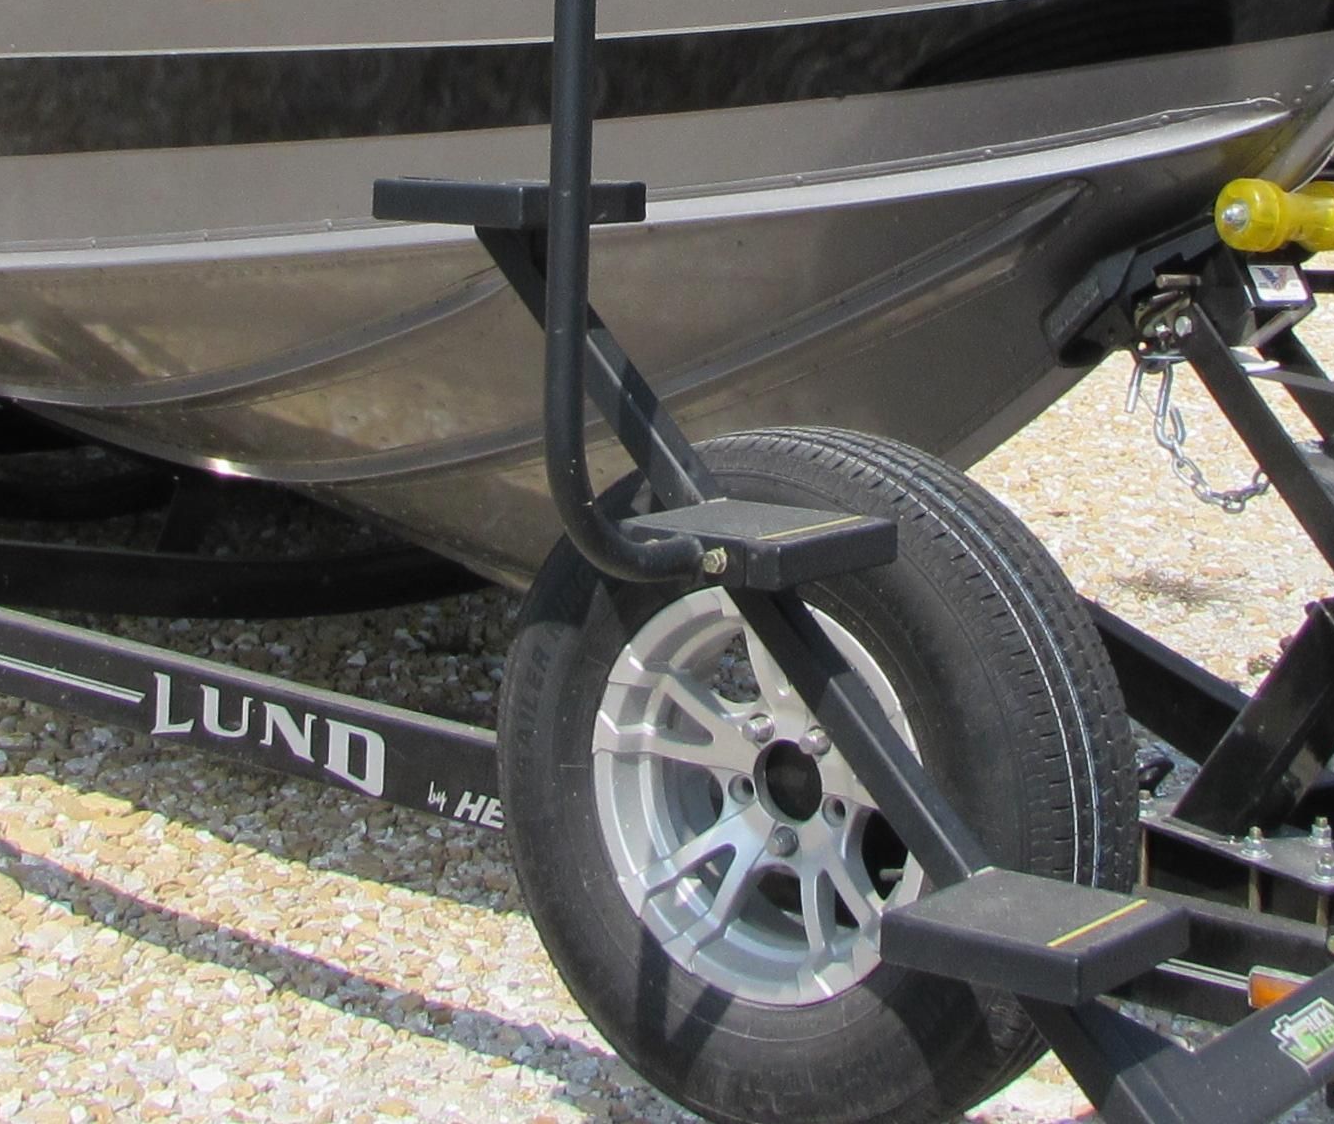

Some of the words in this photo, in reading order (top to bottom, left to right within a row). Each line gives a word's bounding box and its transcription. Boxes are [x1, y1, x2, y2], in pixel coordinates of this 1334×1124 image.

[151, 671, 386, 797] LUND
[427, 781, 448, 812] by
[454, 791, 505, 830] HE
